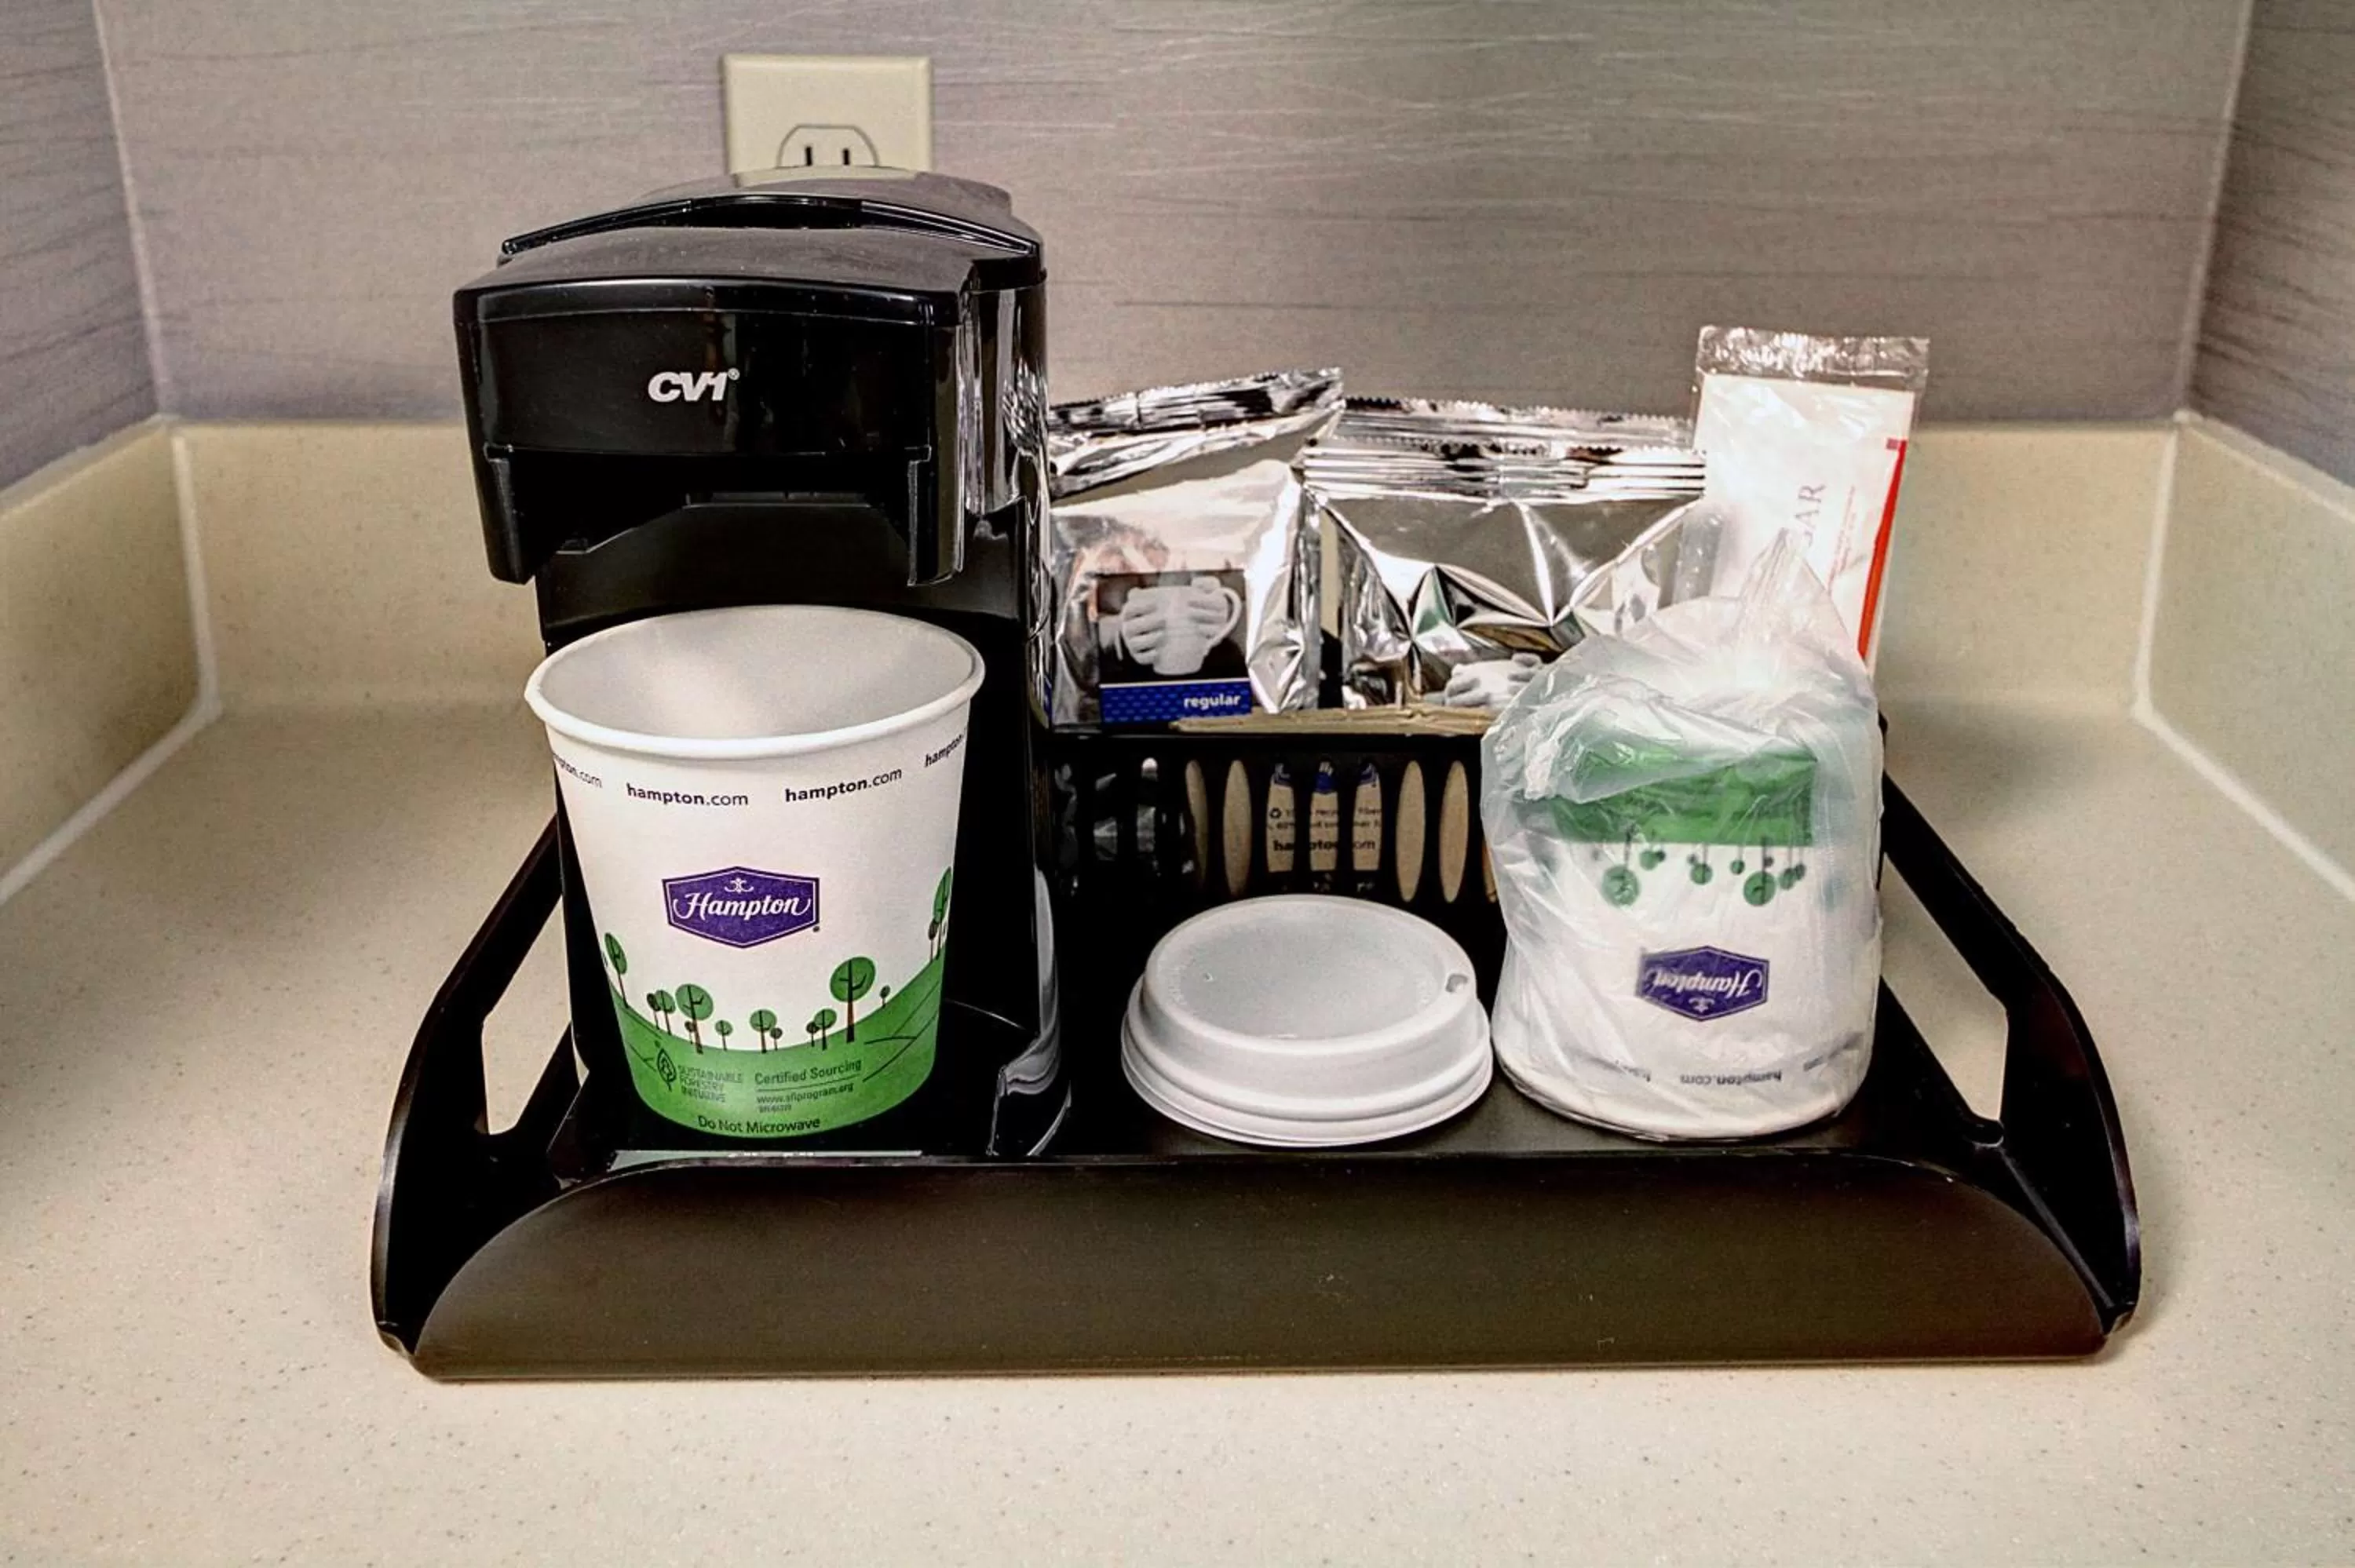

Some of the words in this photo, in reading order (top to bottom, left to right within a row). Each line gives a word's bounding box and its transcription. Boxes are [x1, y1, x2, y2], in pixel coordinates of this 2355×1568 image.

[1183, 693, 1242, 711] regular
[627, 782, 749, 807] hampton.com
[784, 766, 903, 803] hampton.com
[673, 890, 812, 921] Hampton
[1645, 966, 1764, 1000] Hampton
[754, 1069, 807, 1085] Certified
[809, 1059, 862, 1081] Sourcing
[698, 1115, 717, 1130] Do
[718, 1118, 743, 1134] Not
[747, 1117, 821, 1134] Microwave
